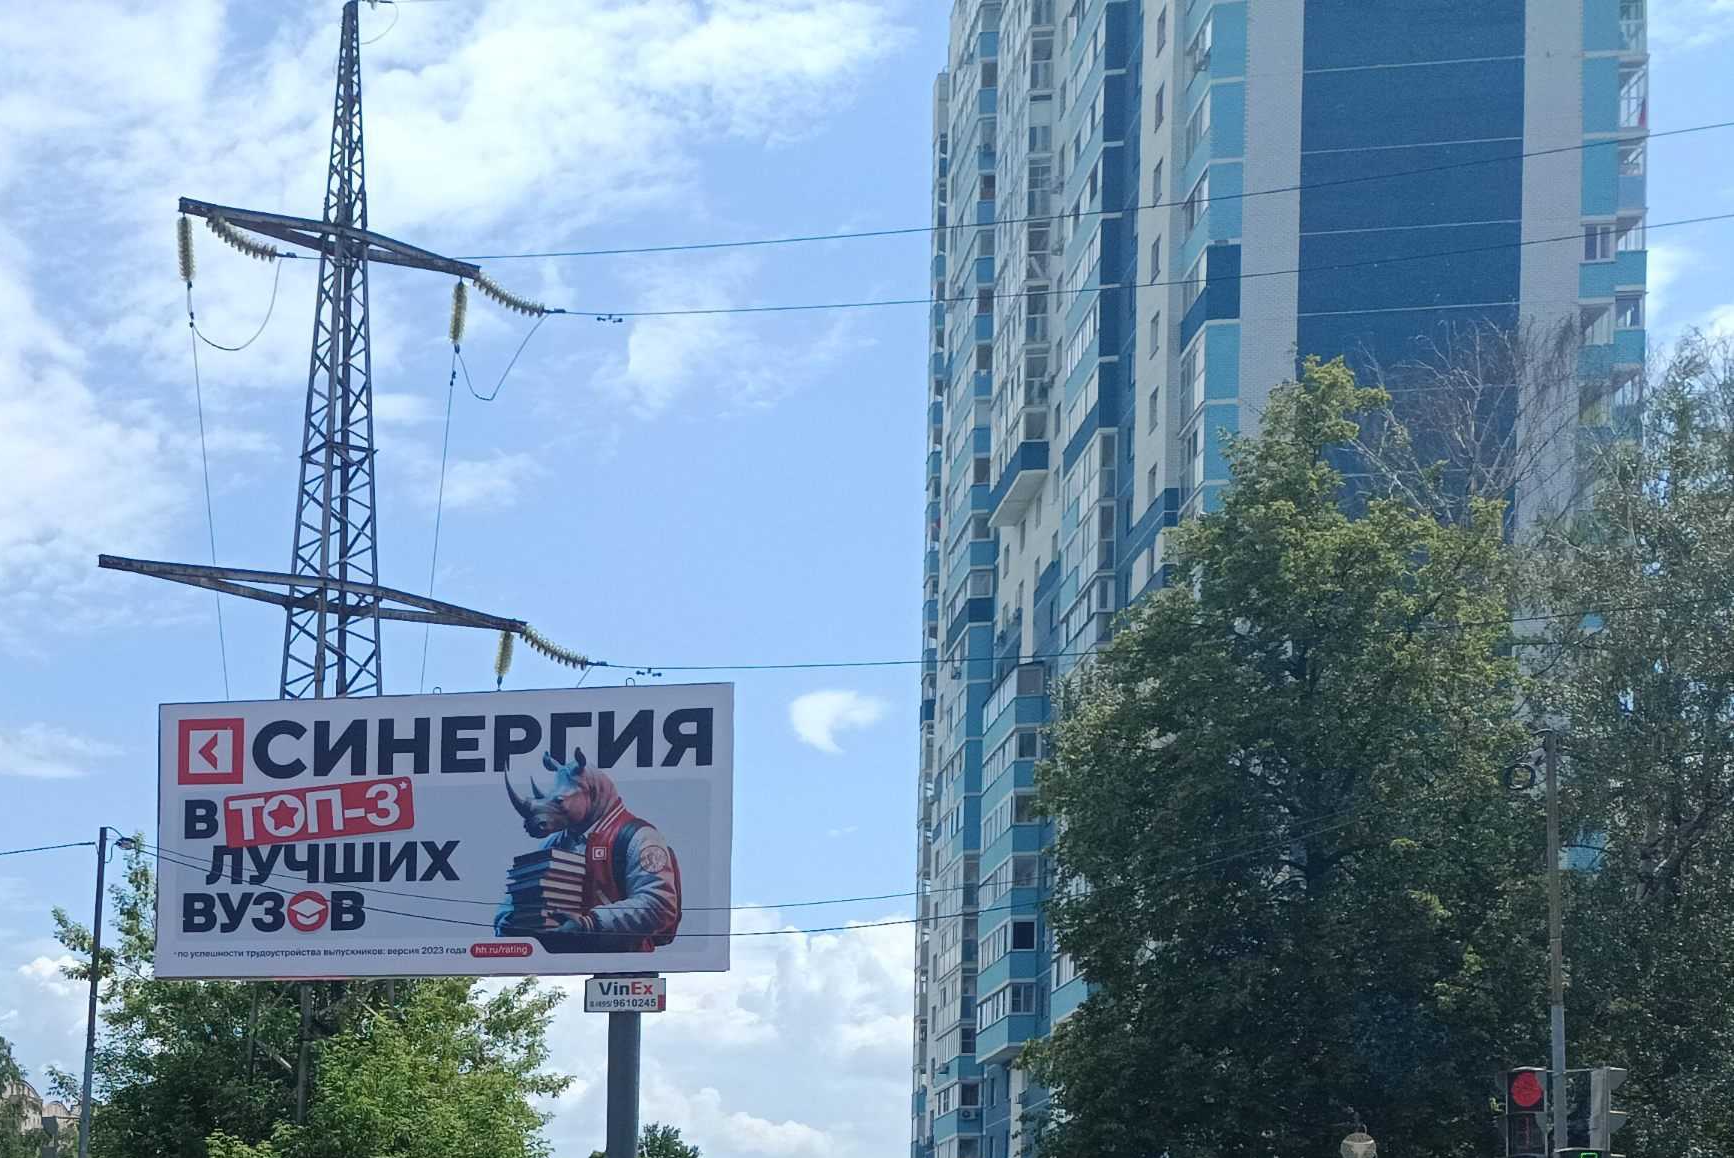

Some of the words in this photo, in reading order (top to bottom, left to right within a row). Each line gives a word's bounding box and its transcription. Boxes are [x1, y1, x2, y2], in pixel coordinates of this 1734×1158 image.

[252, 708, 714, 779] СИНЕРГИЯ
[184, 799, 219, 839] В
[205, 840, 461, 885] ЛУЧШИХ
[182, 890, 366, 933] ВУЗОВ
[190, 950, 244, 959] успешности
[246, 947, 322, 958] трудоустройства
[421, 946, 444, 955] 2023
[446, 947, 467, 955] года
[599, 982, 653, 996] VinEx
